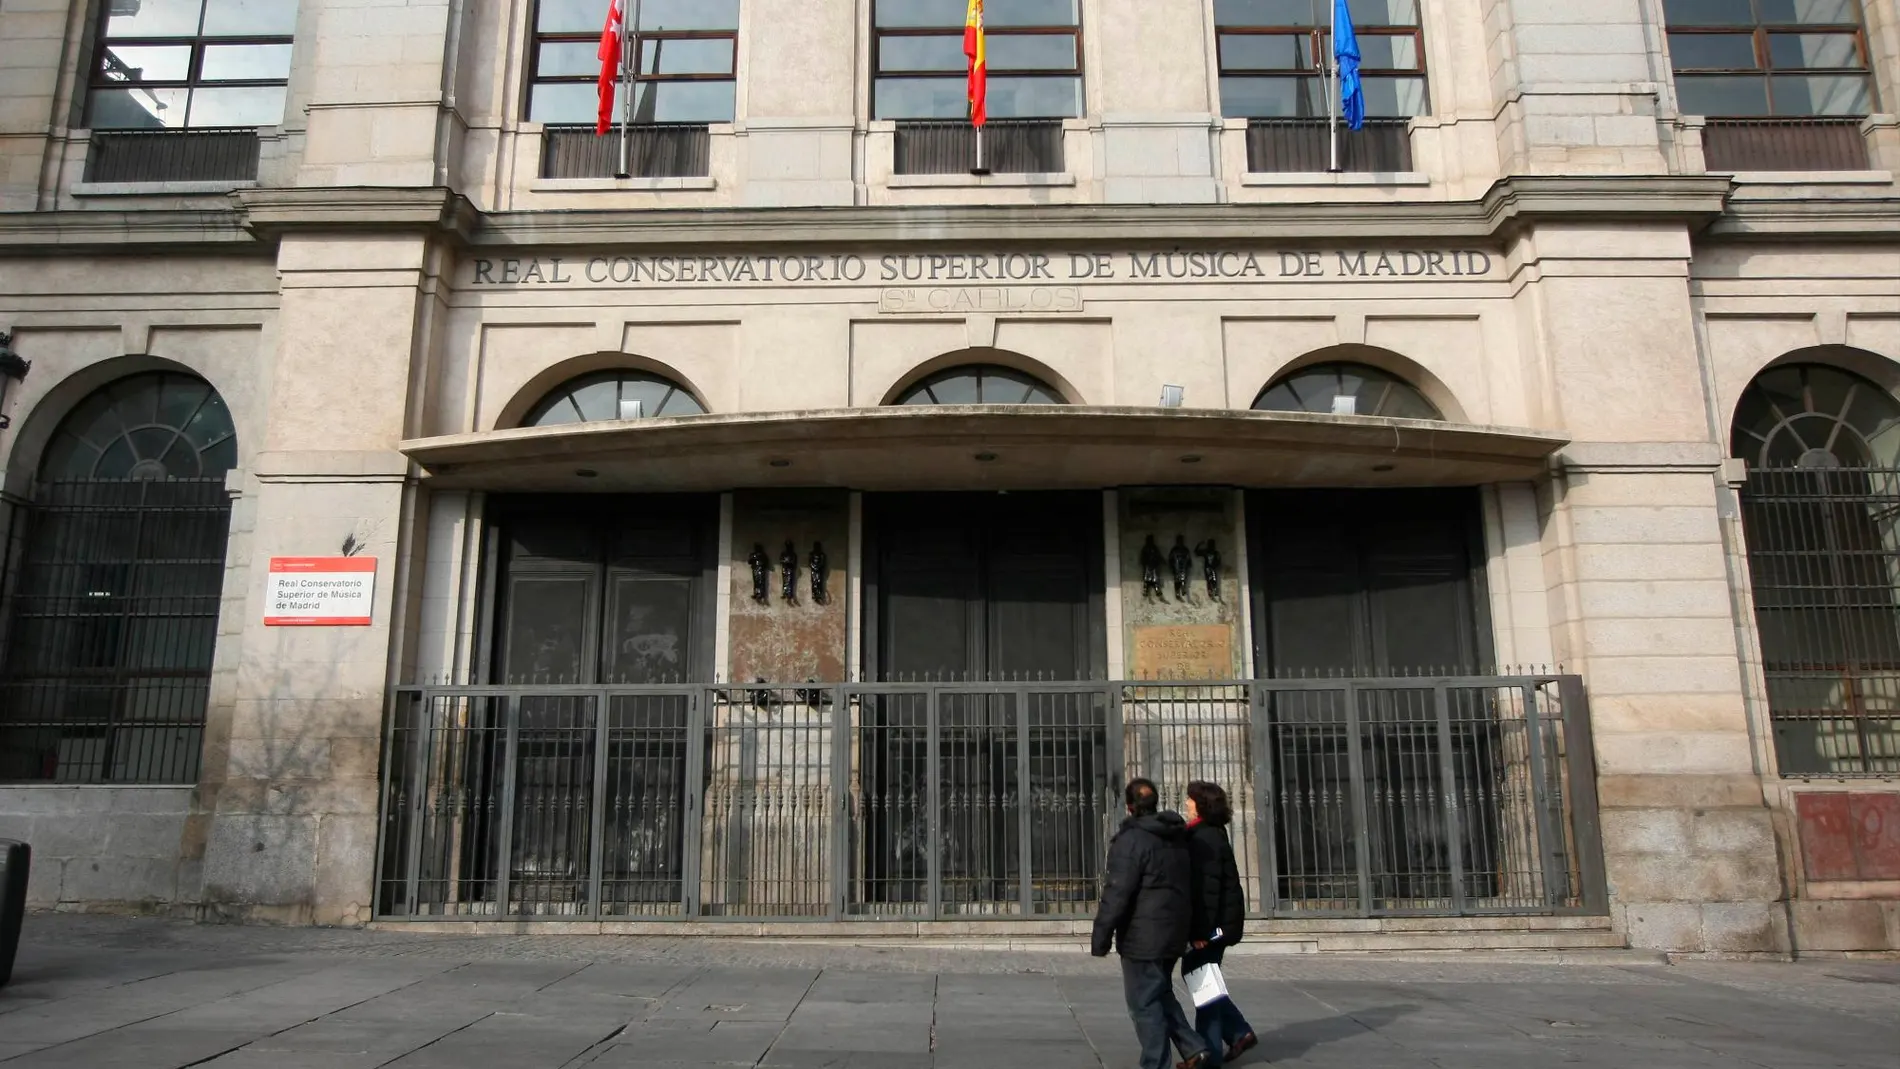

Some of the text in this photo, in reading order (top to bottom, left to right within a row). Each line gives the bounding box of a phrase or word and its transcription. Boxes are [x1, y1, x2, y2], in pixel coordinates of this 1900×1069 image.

[472, 246, 1492, 284] REAL CONSERVATORIO SUPERIOR DE MÚSICA DE MADRID
[278, 579, 362, 588] Real Conservatorio
[277, 590, 362, 601] Superior de Música
[275, 602, 321, 610] de Madrid
